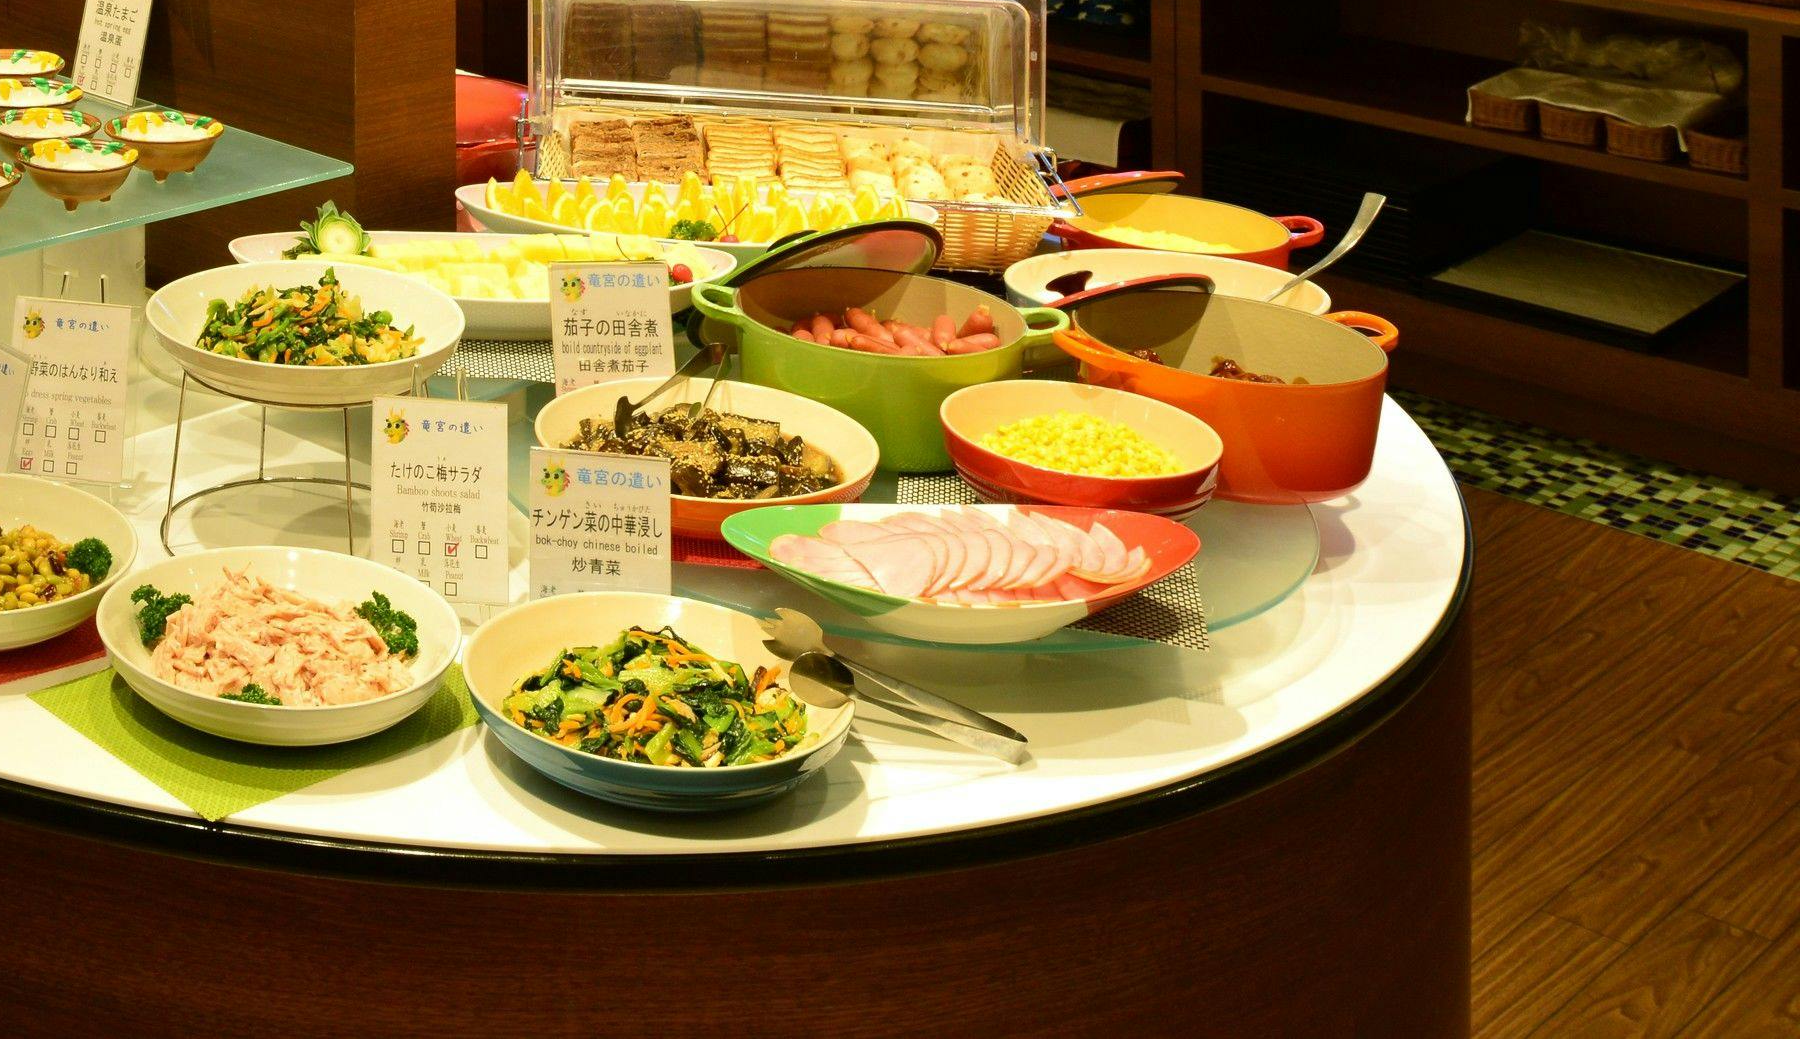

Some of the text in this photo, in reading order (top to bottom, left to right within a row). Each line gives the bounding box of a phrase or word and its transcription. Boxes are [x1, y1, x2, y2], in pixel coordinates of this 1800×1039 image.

[563, 317, 659, 338] 茄子の田舎煮
[582, 341, 621, 356] countryside
[624, 341, 631, 354] of
[634, 342, 663, 357] eggplant
[579, 359, 649, 373] 田舎煮茄子
[75, 394, 112, 406] vegetables
[390, 462, 482, 483] たけのこ梅サラダ
[397, 484, 481, 500] Bamboo shoots salad
[532, 509, 663, 538] チンゲン菜の中華浸し
[535, 534, 658, 556] bok-choy chinese boiled
[572, 556, 621, 576] 炒青菜
